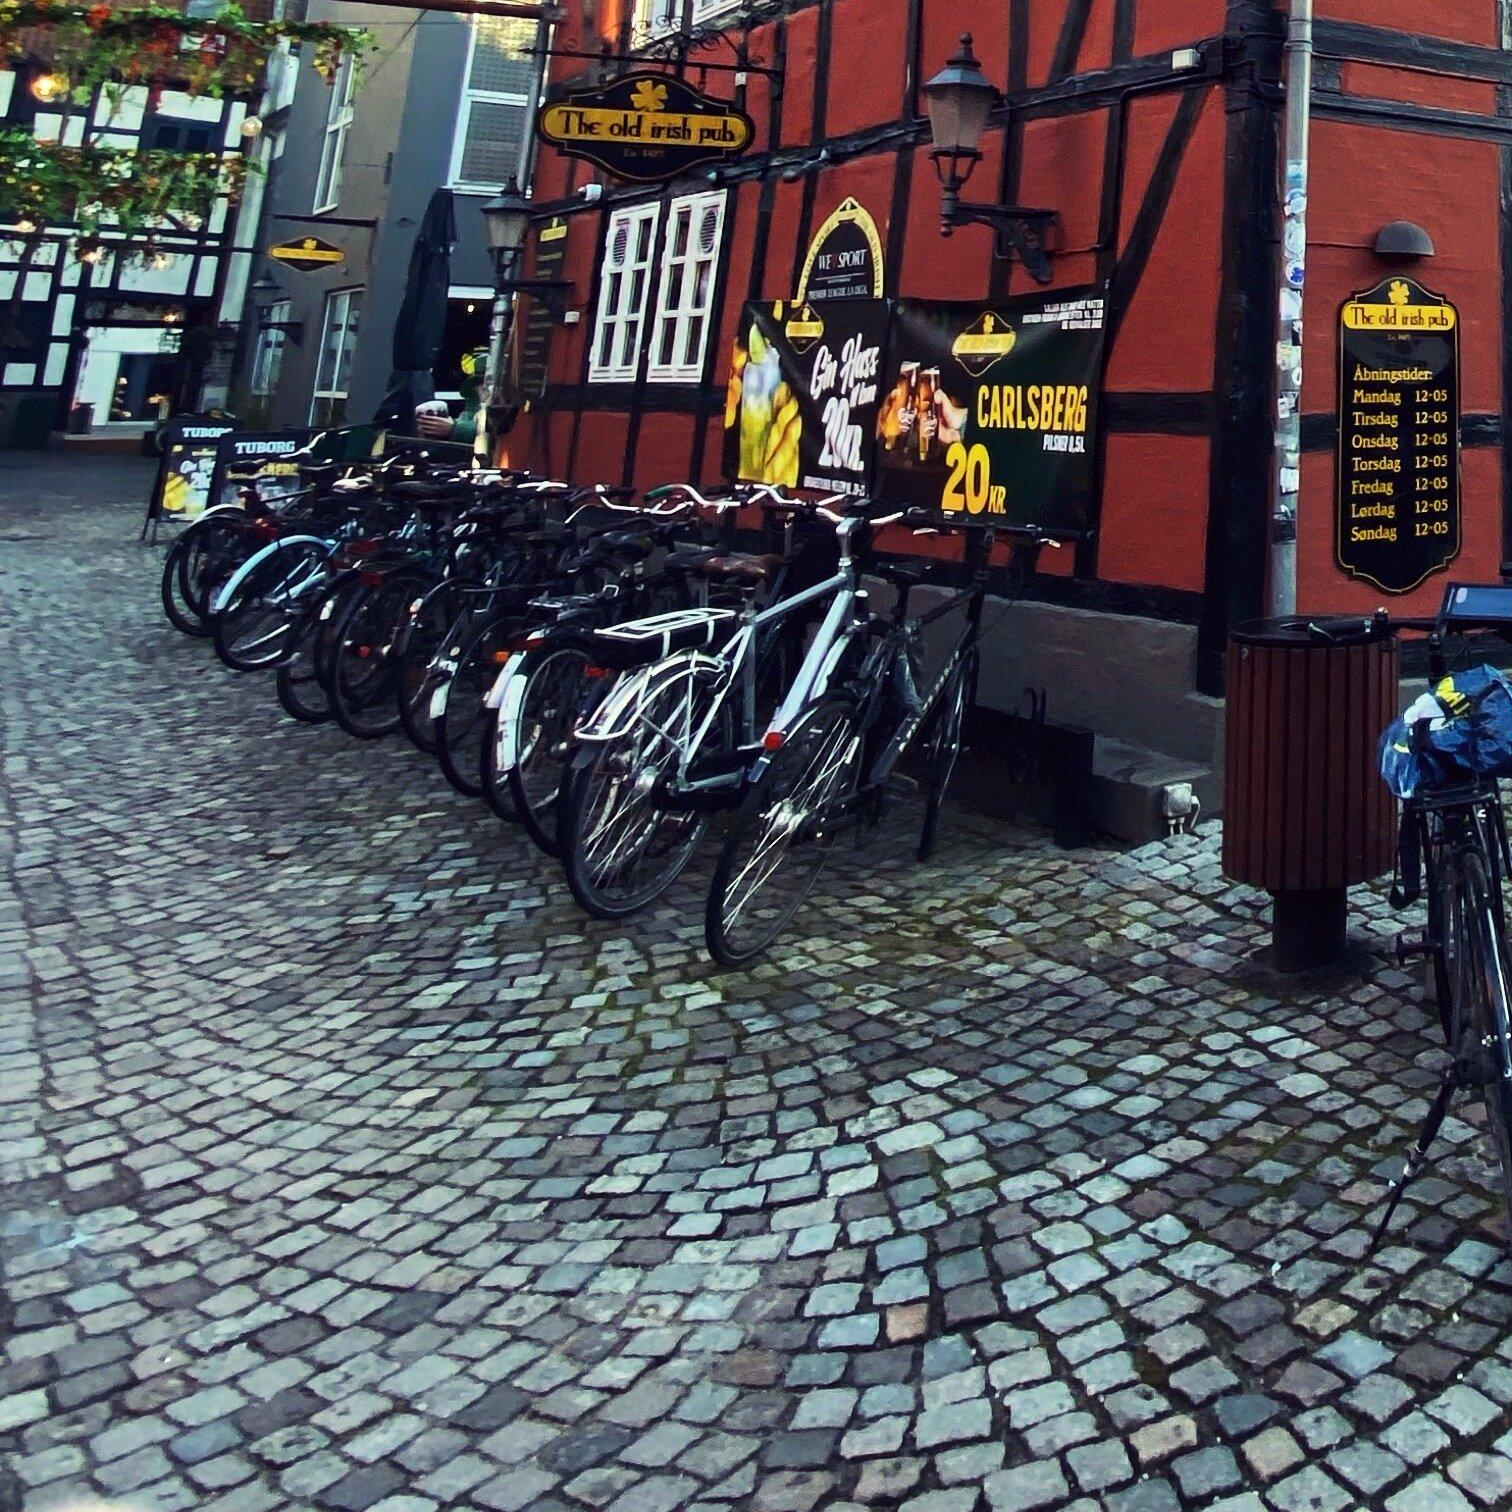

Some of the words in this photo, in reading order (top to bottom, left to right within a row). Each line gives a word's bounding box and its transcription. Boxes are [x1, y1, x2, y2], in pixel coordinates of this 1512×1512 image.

[558, 109, 602, 136] The
[608, 113, 644, 138] old
[651, 117, 692, 141] irish
[700, 119, 735, 144] pub
[837, 249, 868, 269] SPORT
[1350, 306, 1375, 326] The
[1379, 308, 1397, 326] old
[1401, 308, 1425, 326] irish
[1428, 308, 1449, 328] pub
[1353, 389, 1402, 406] Mandag
[1415, 389, 1448, 403] 12-05
[977, 384, 1088, 432] CARLSBERG
[1352, 411, 1399, 428] Tirsdag
[1415, 411, 1448, 424] 12-05
[234, 440, 296, 455] TUBORG
[1351, 433, 1399, 451] Onsdag
[1415, 432, 1448, 446] 12-05
[1351, 456, 1402, 473] Torsdag
[1415, 454, 1448, 468] 12-05
[941, 442, 991, 515] 20
[988, 485, 1007, 515] KR.
[1351, 479, 1394, 496] Fredag
[1415, 476, 1448, 491] 12-05
[1351, 502, 1395, 519] Lørdag
[1414, 499, 1449, 514] 12-05
[1350, 524, 1398, 542] Søndag
[1415, 521, 1449, 537] 12-05
